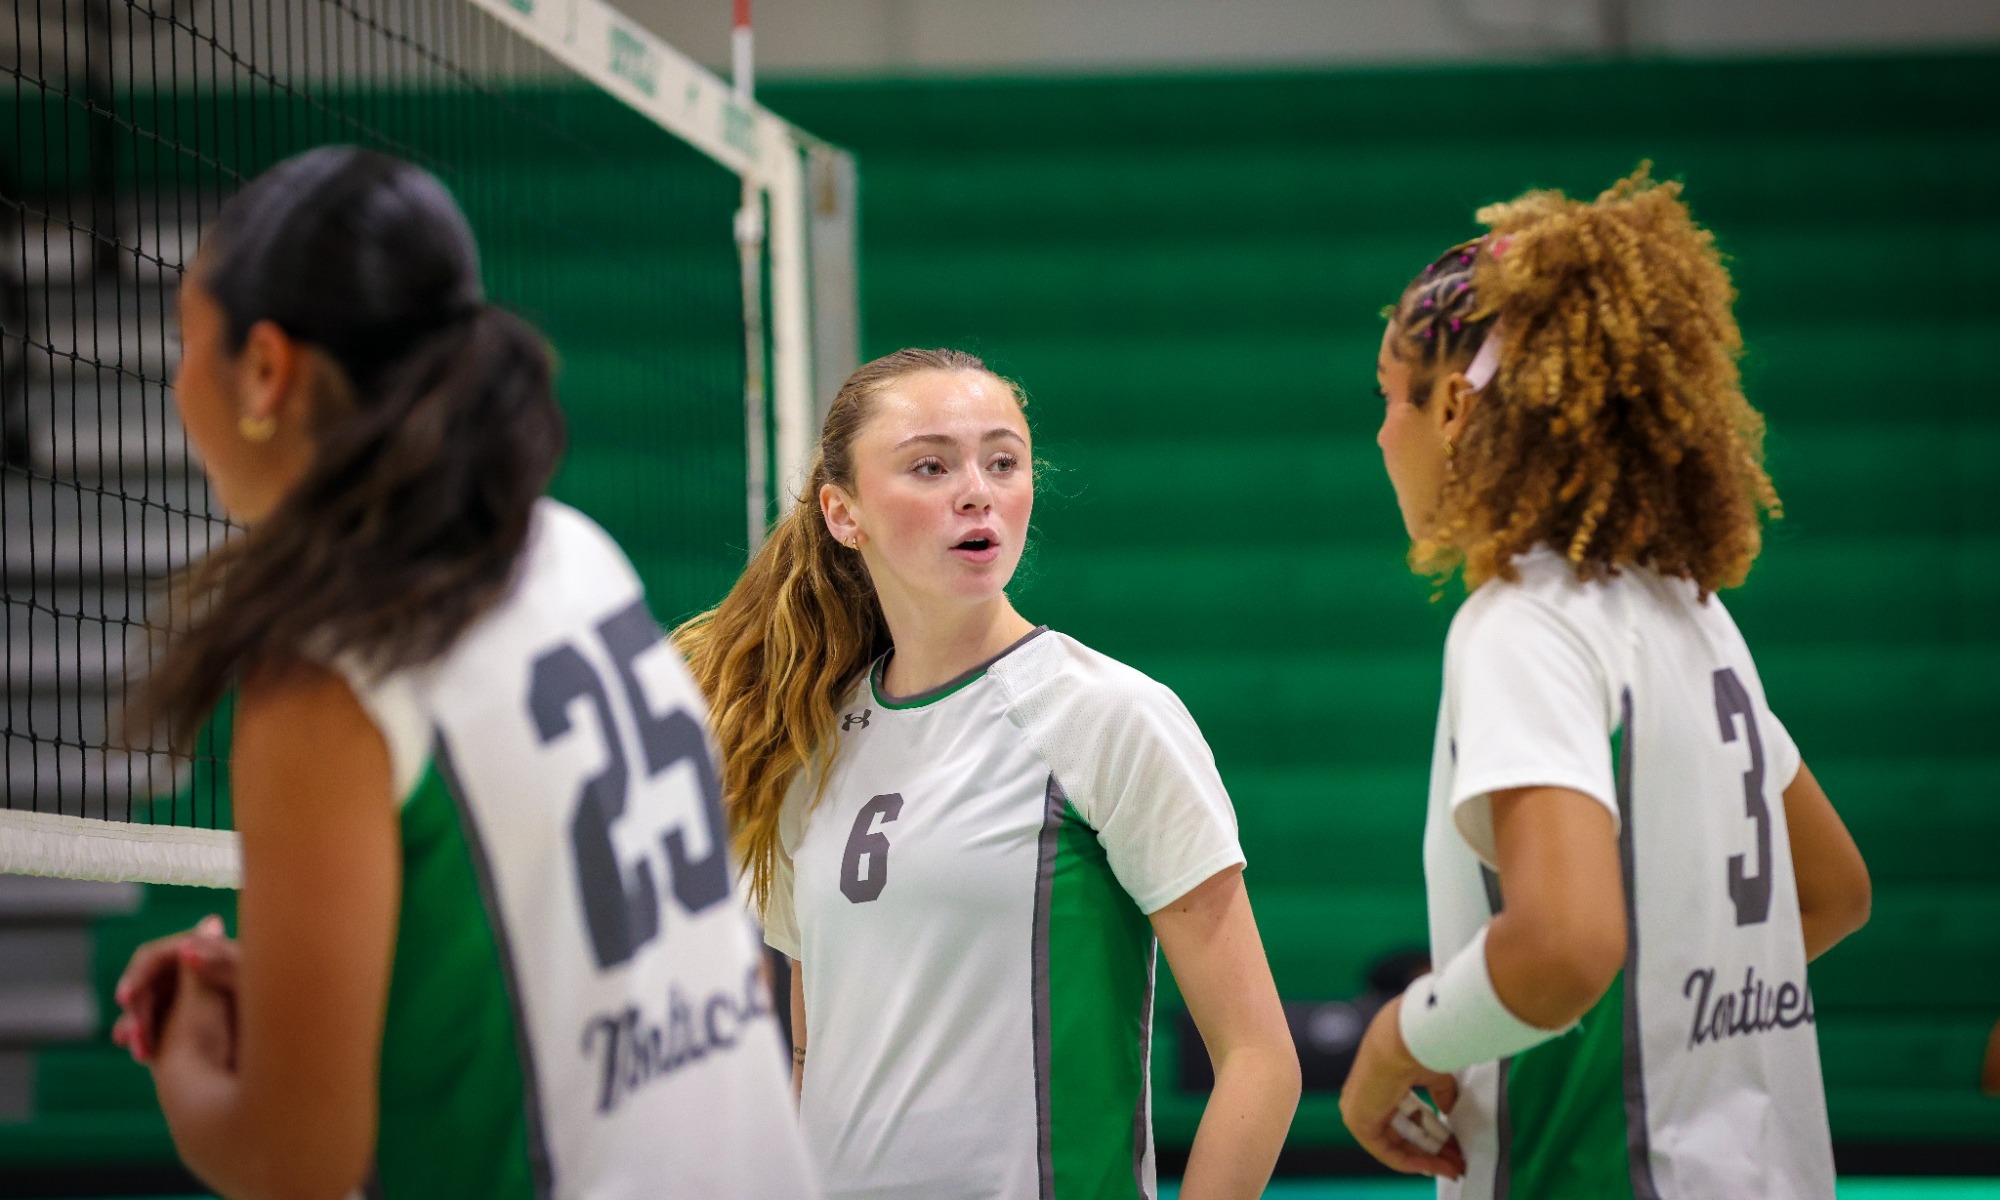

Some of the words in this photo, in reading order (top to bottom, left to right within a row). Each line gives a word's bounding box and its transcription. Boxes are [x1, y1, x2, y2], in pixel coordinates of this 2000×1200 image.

[526, 600, 731, 968] 25
[840, 793, 904, 904] 6
[1712, 667, 1771, 926] 3
